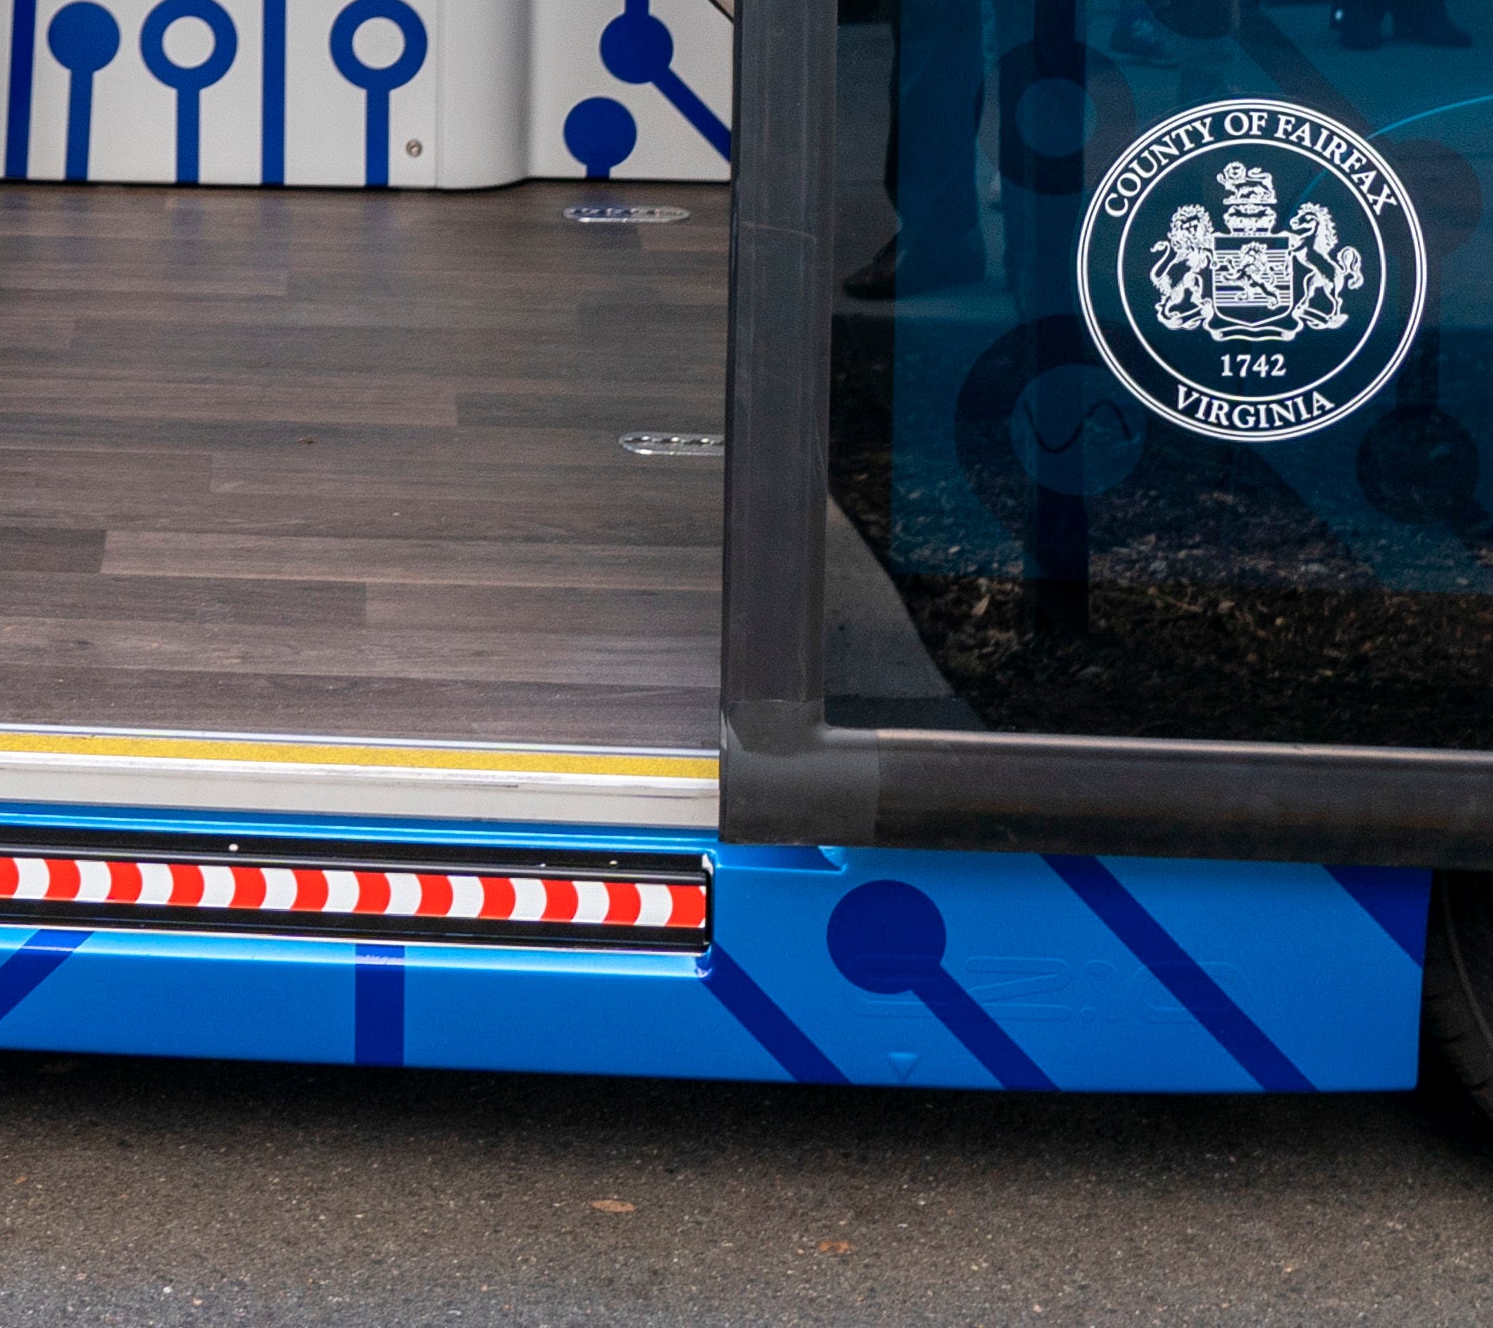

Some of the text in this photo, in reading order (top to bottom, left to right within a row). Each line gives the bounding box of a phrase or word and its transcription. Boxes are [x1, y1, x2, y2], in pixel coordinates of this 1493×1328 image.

[1104, 111, 1399, 218] COUNTY OF FAIRFAX
[1220, 353, 1288, 378] 1742
[1176, 384, 1336, 430] VIRGINIA
